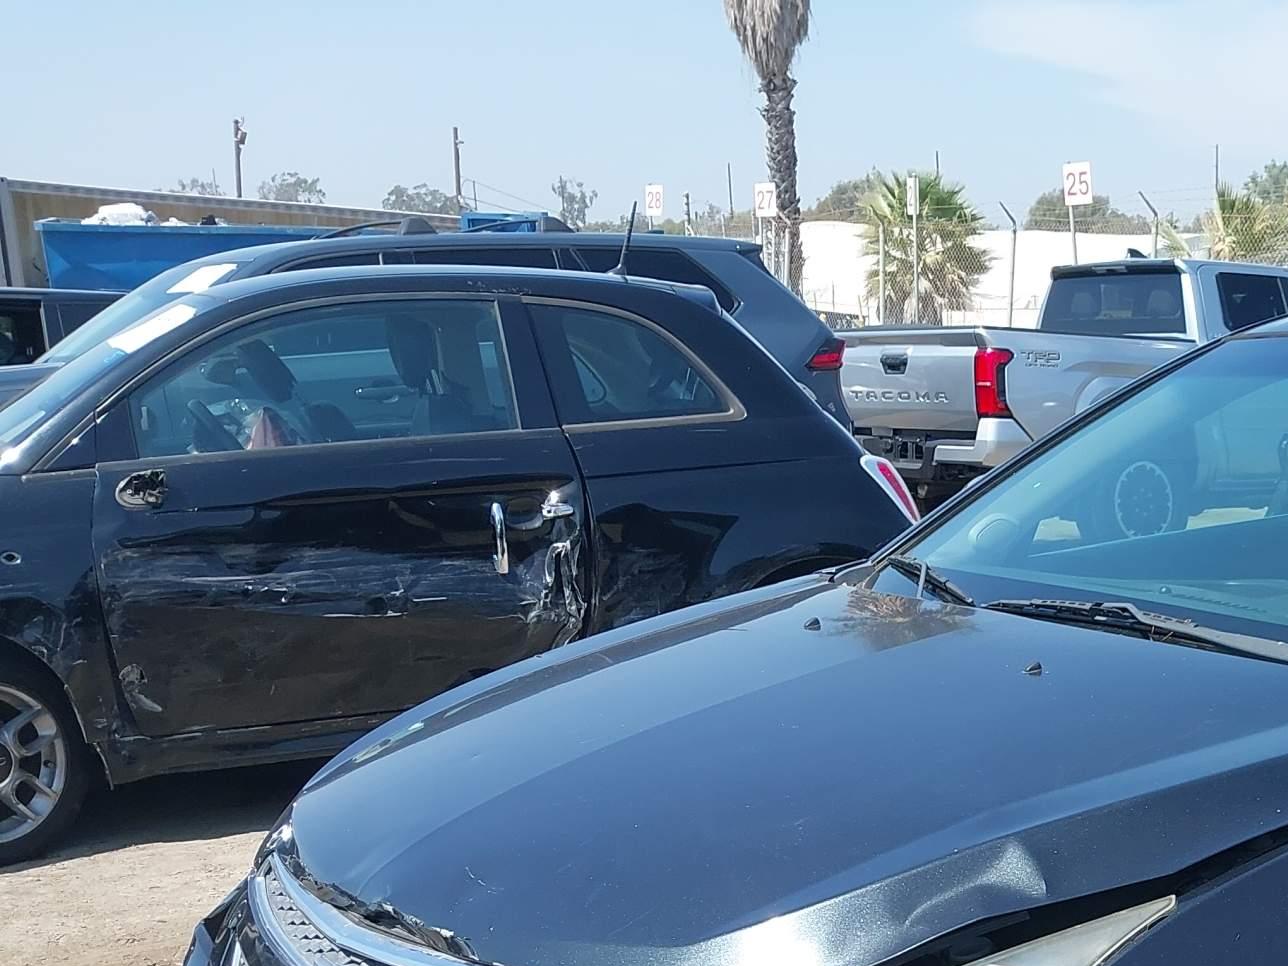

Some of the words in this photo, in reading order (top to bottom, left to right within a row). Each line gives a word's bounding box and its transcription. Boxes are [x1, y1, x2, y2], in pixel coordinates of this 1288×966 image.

[1066, 171, 1090, 196] 25
[647, 191, 662, 208] 28
[757, 190, 773, 209] 27
[849, 390, 949, 403] TACOMA
